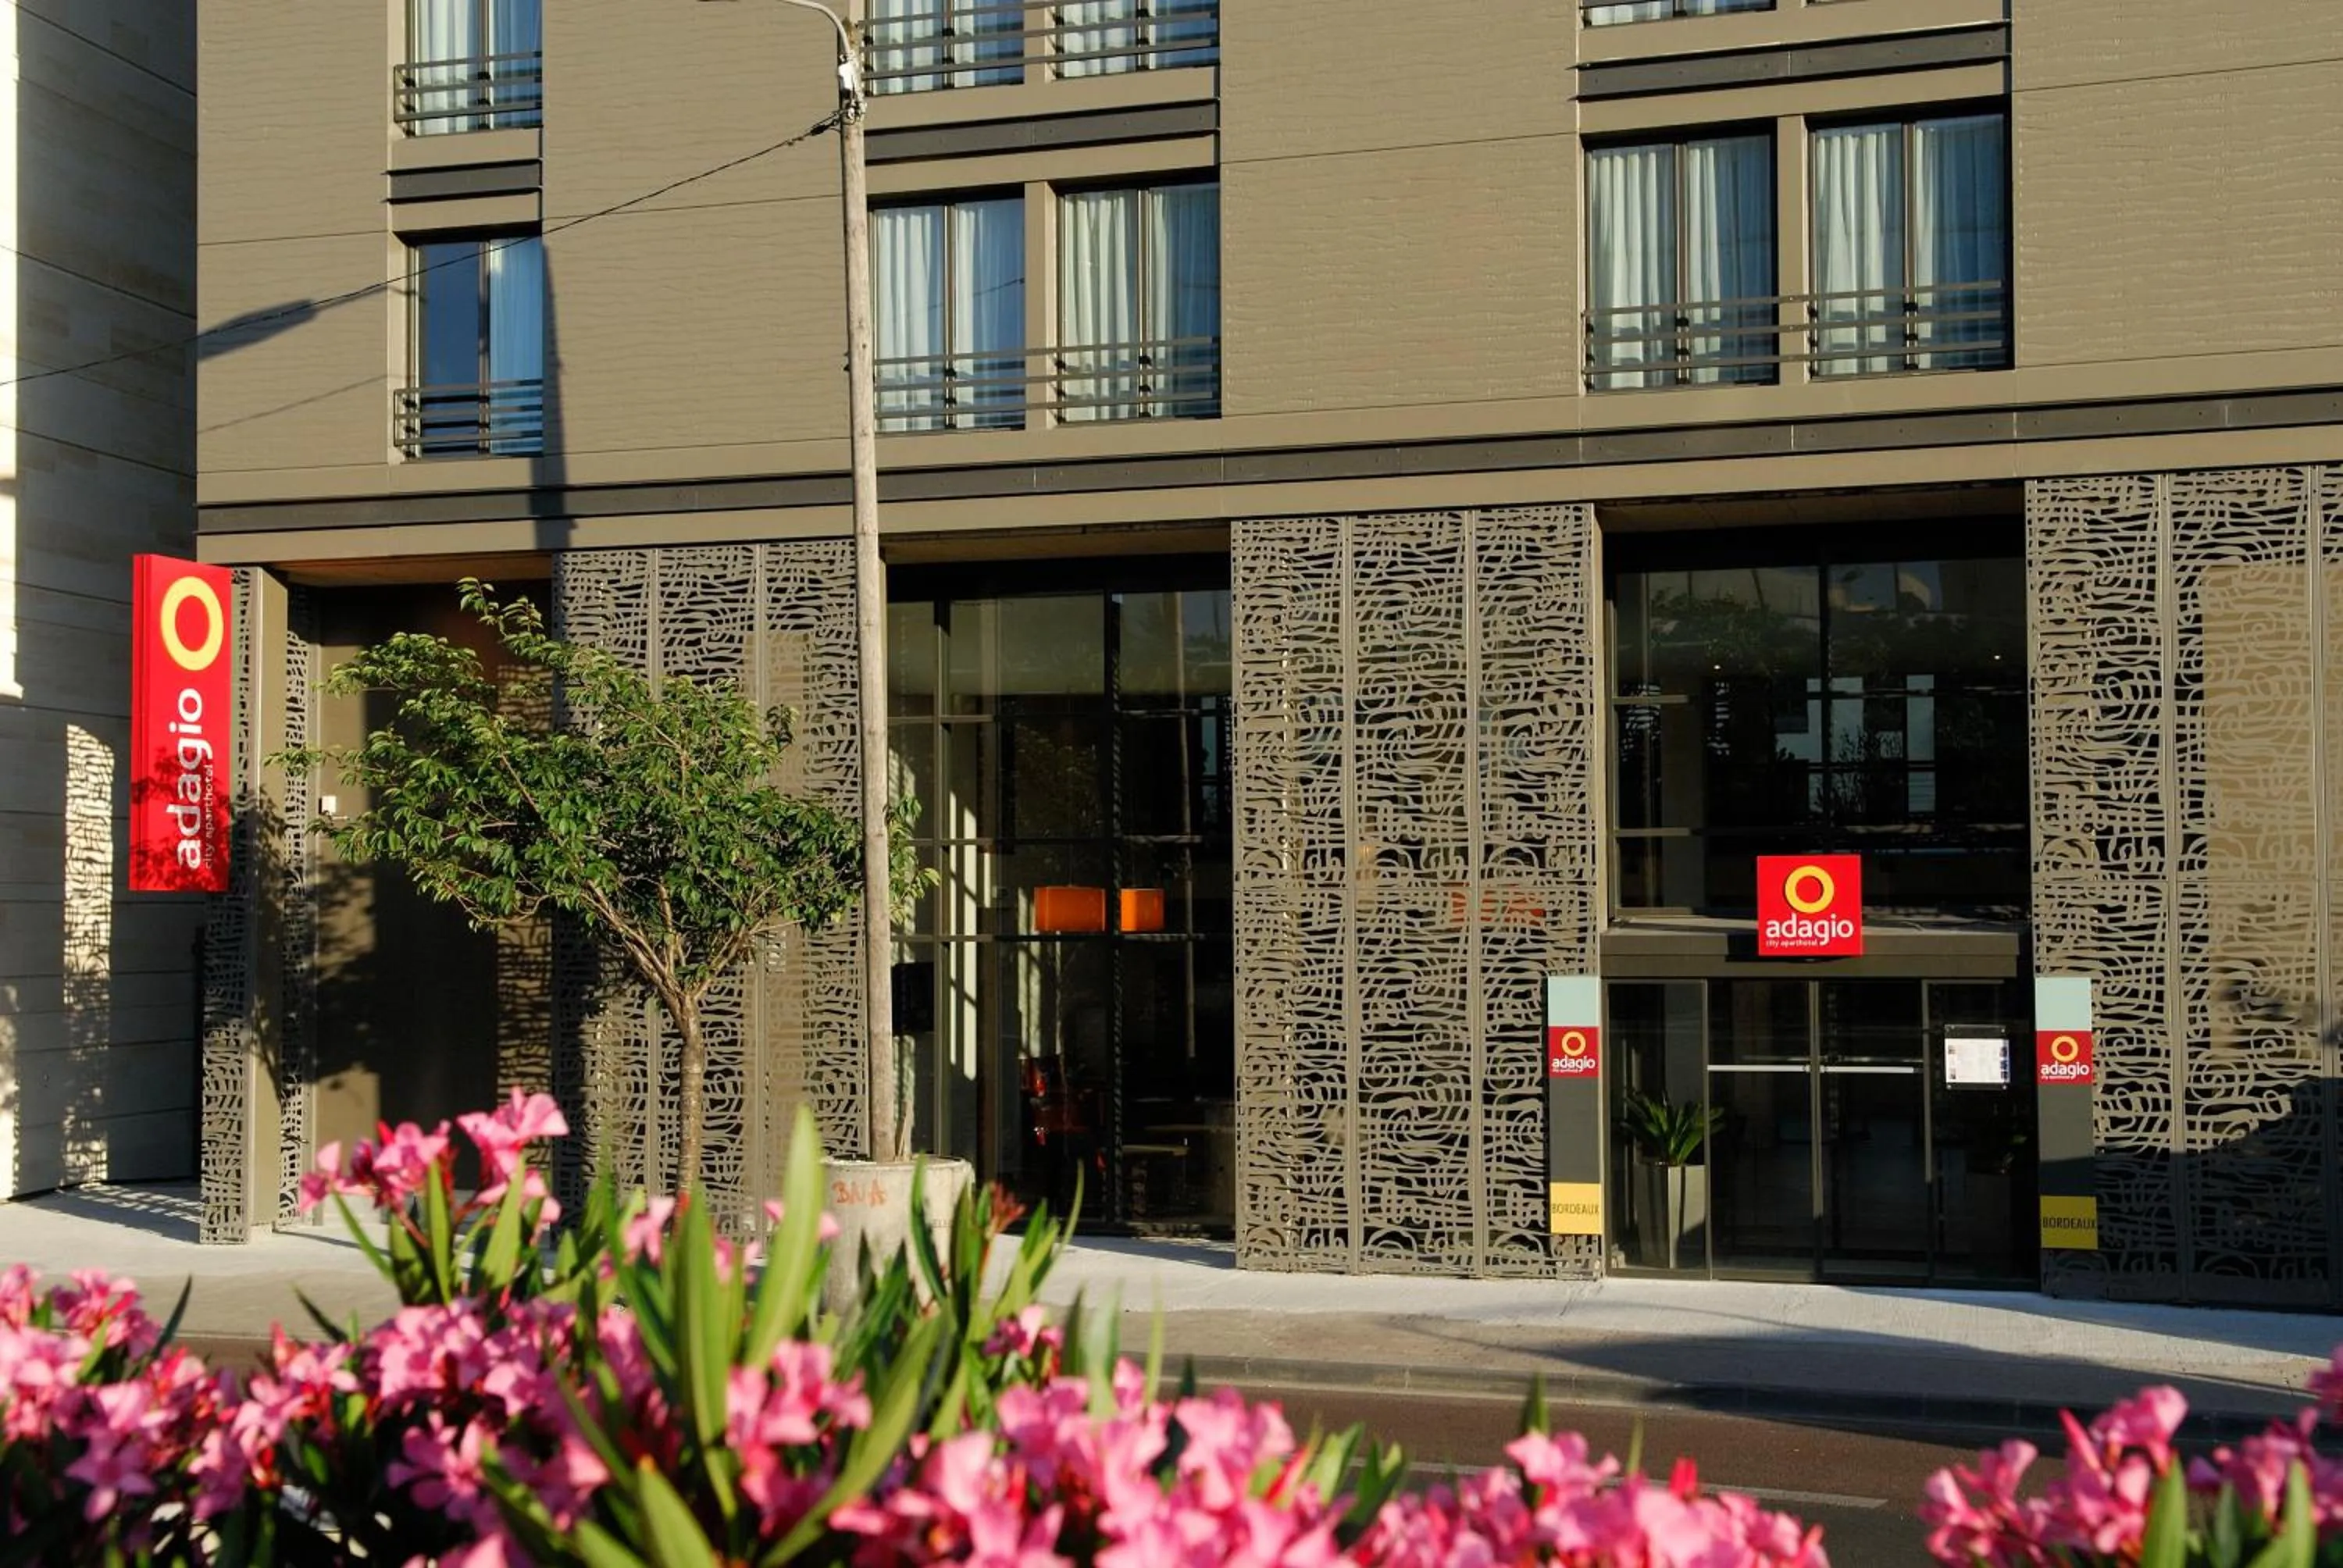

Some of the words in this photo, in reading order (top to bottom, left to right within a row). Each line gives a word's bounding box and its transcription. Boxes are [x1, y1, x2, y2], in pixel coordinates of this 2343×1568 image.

[166, 687, 213, 870] adagio
[203, 764, 215, 839] aparthotel
[203, 844, 215, 869] city
[1766, 912, 1854, 946] adagio
[1552, 1055, 1596, 1072] adagio
[2041, 1060, 2090, 1079] adagio
[1551, 1203, 1600, 1215] BORDEAUX
[2042, 1217, 2095, 1229] BORDEAUX
